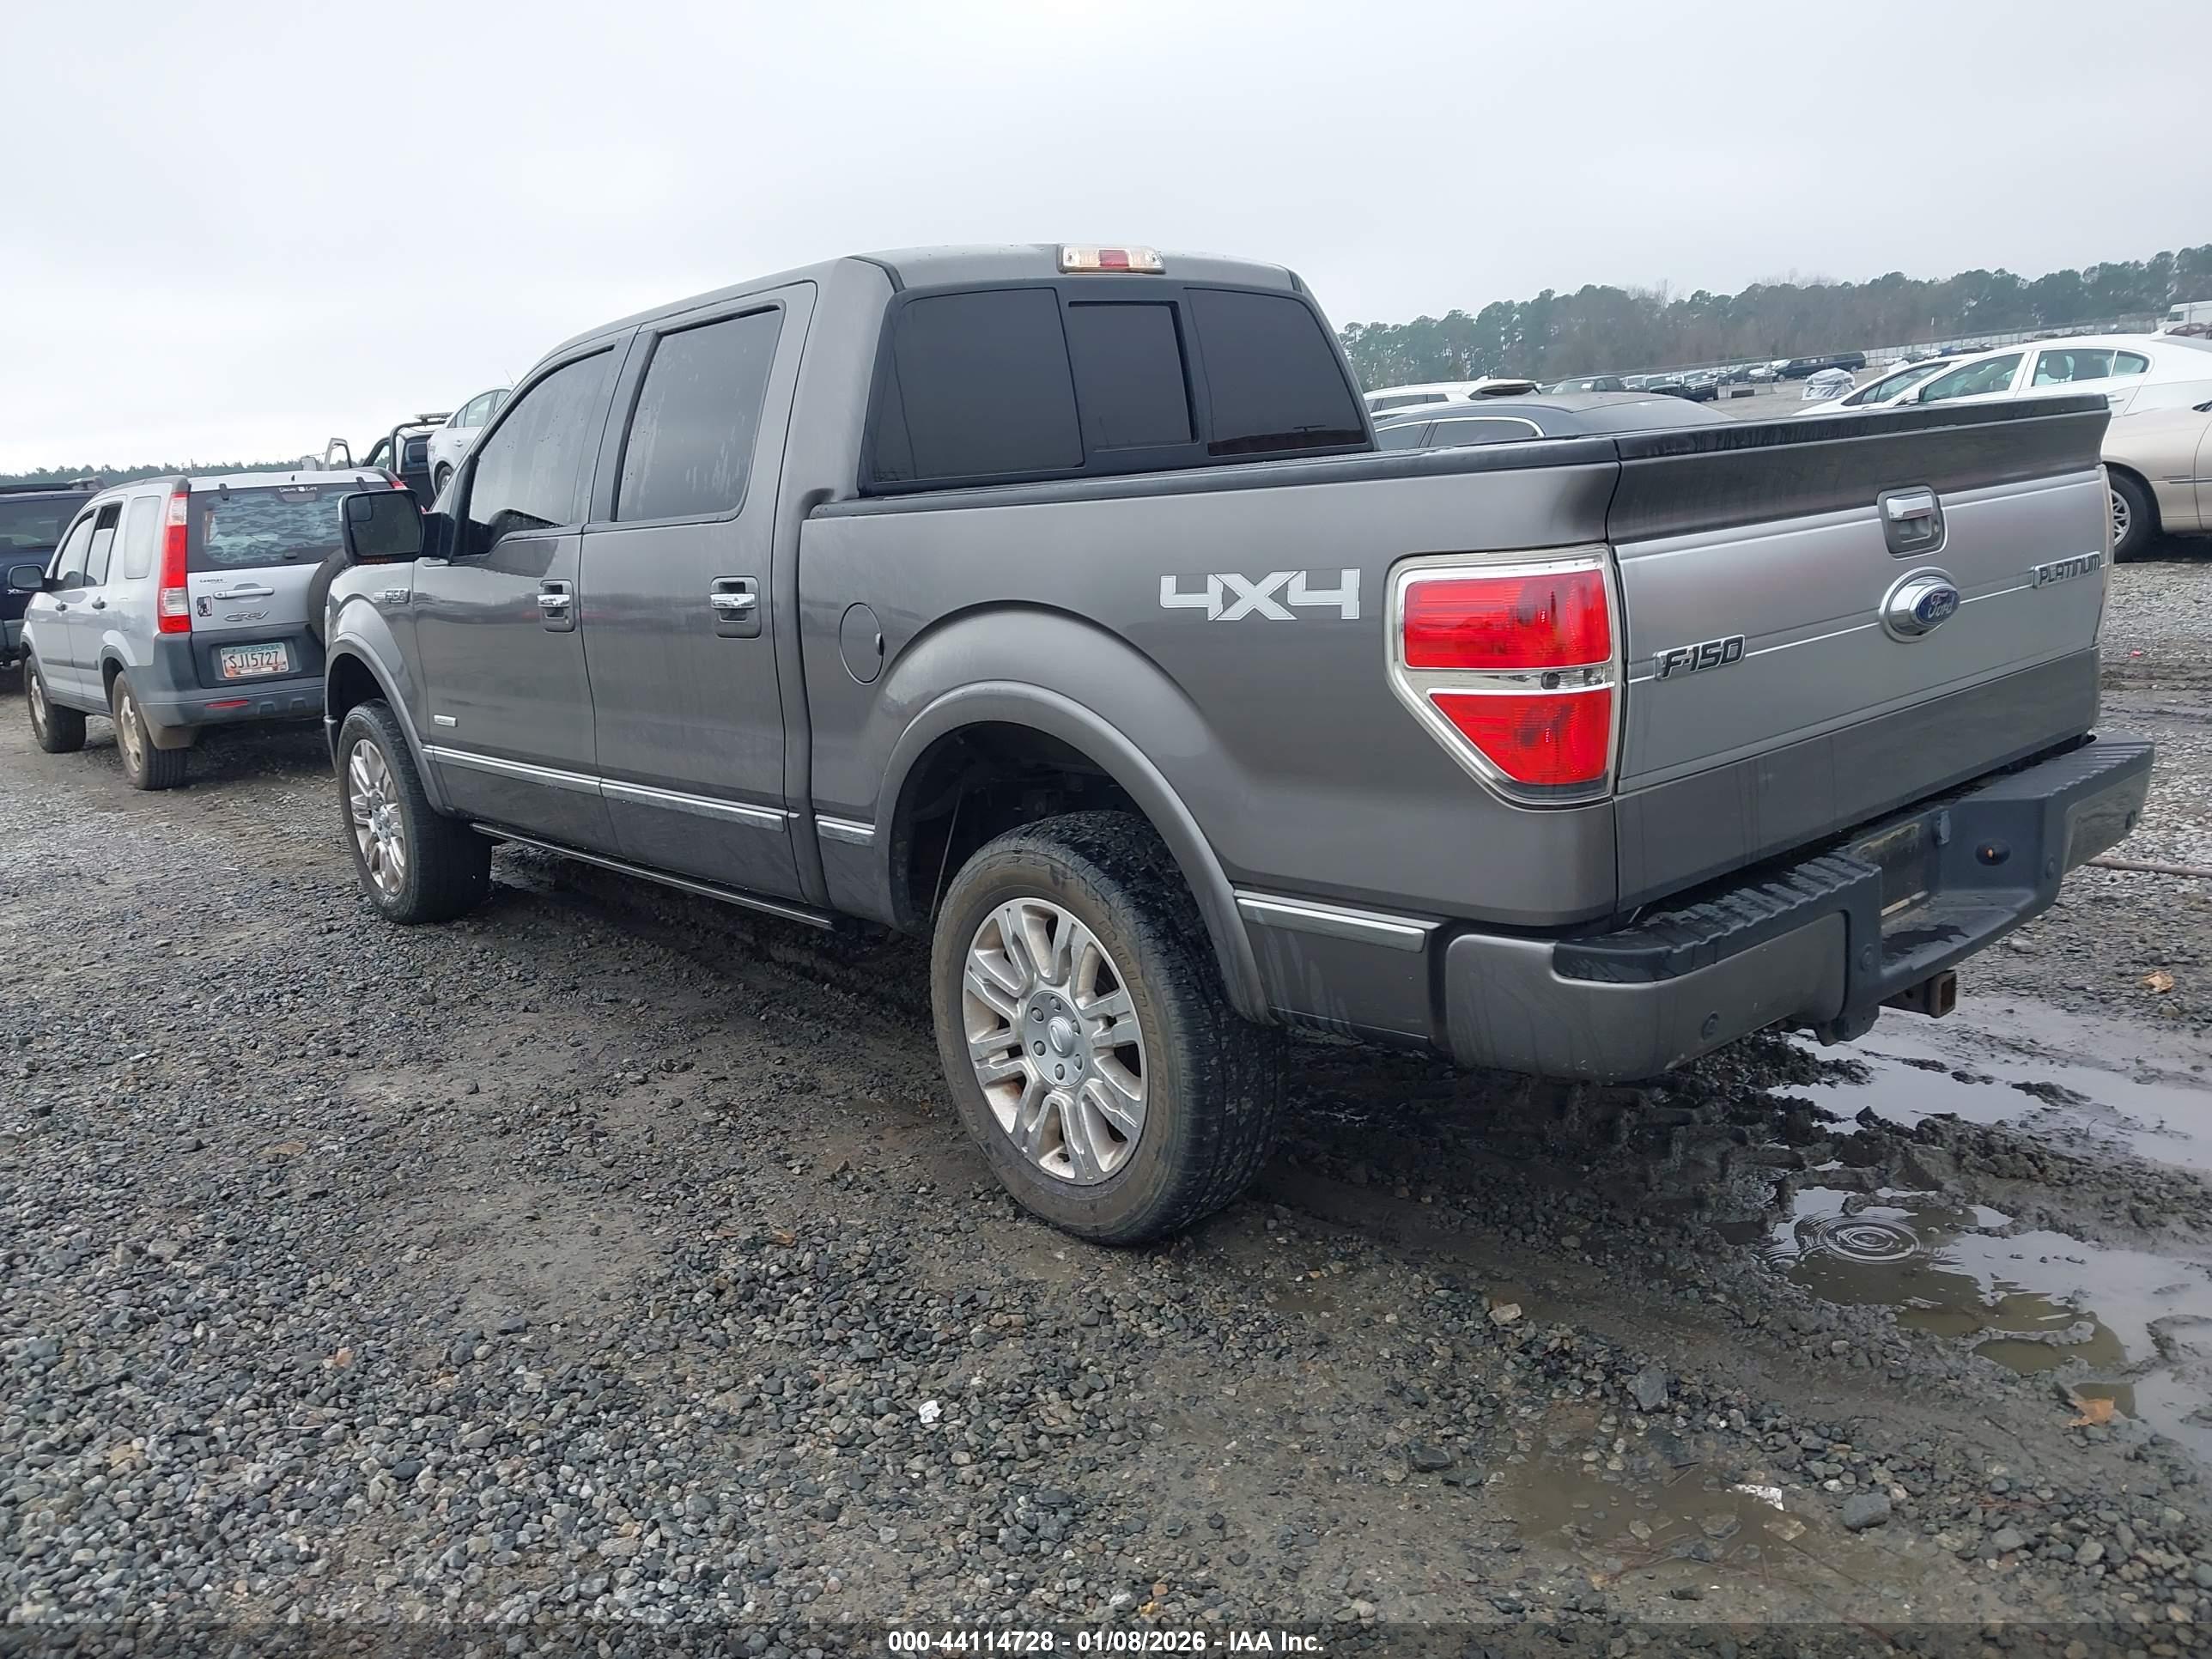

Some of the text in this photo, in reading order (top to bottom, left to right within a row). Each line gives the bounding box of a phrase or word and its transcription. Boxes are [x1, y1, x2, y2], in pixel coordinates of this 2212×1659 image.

[2038, 553, 2100, 586] PLATINUM
[1928, 591, 1956, 618] Ford
[1661, 635, 1745, 679] F-150
